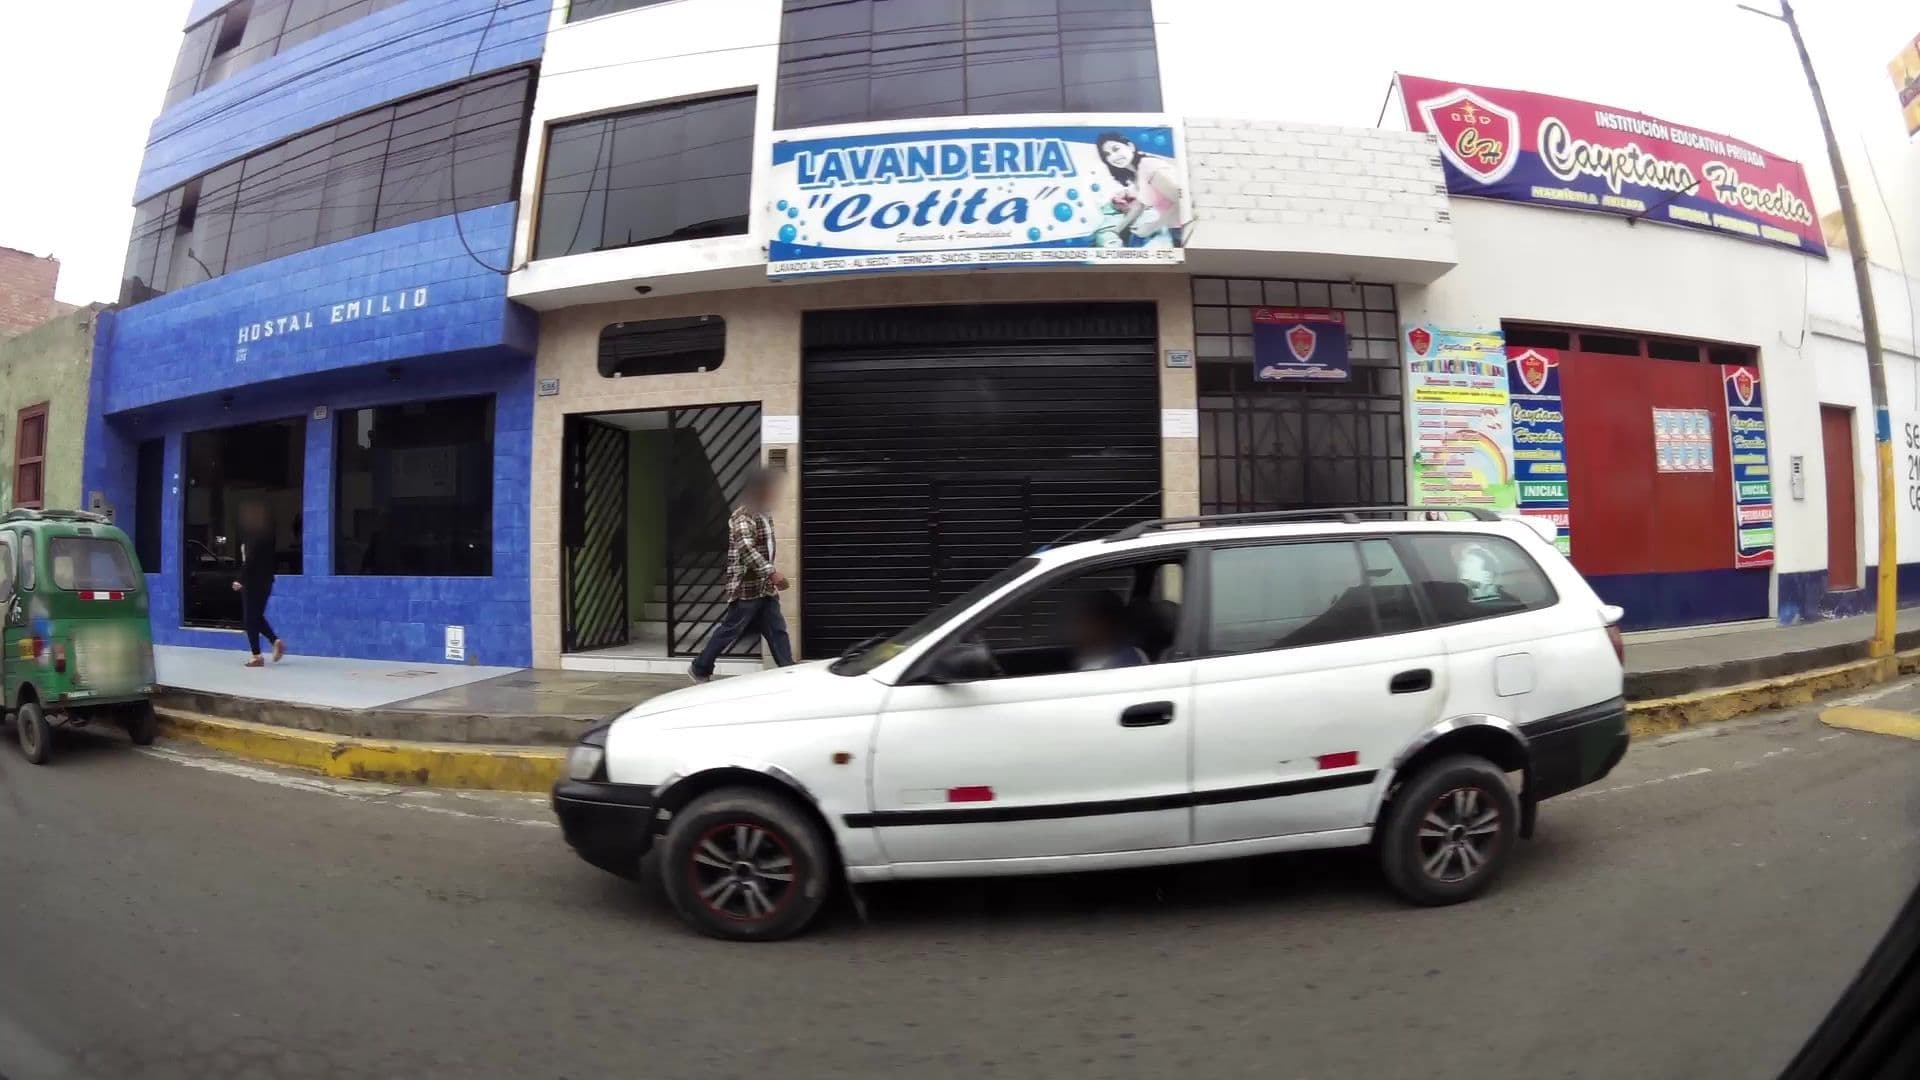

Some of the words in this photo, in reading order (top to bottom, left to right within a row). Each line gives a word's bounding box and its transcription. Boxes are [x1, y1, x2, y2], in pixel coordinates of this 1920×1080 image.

[797, 140, 1075, 188] LAVANDERIA
[1595, 110, 1669, 141] INSTITUCIÓN
[1670, 128, 1726, 157] EDUCATIVA
[1726, 142, 1766, 168] PRIVADA
[1538, 116, 1699, 196] Cayetano
[1702, 160, 1812, 227] Heredia
[774, 263, 807, 273] LAVADO
[823, 259, 846, 269] PESO
[869, 257, 889, 266] SECO
[898, 255, 933, 265] TERNOS
[941, 253, 971, 263] SACOS
[979, 251, 1033, 261] EDREDONES
[1096, 250, 1148, 259] ALFOMBRAS
[238, 312, 313, 344] HOSTAL
[331, 288, 427, 323] EMILIO
[1524, 485, 1564, 497] INICIAL
